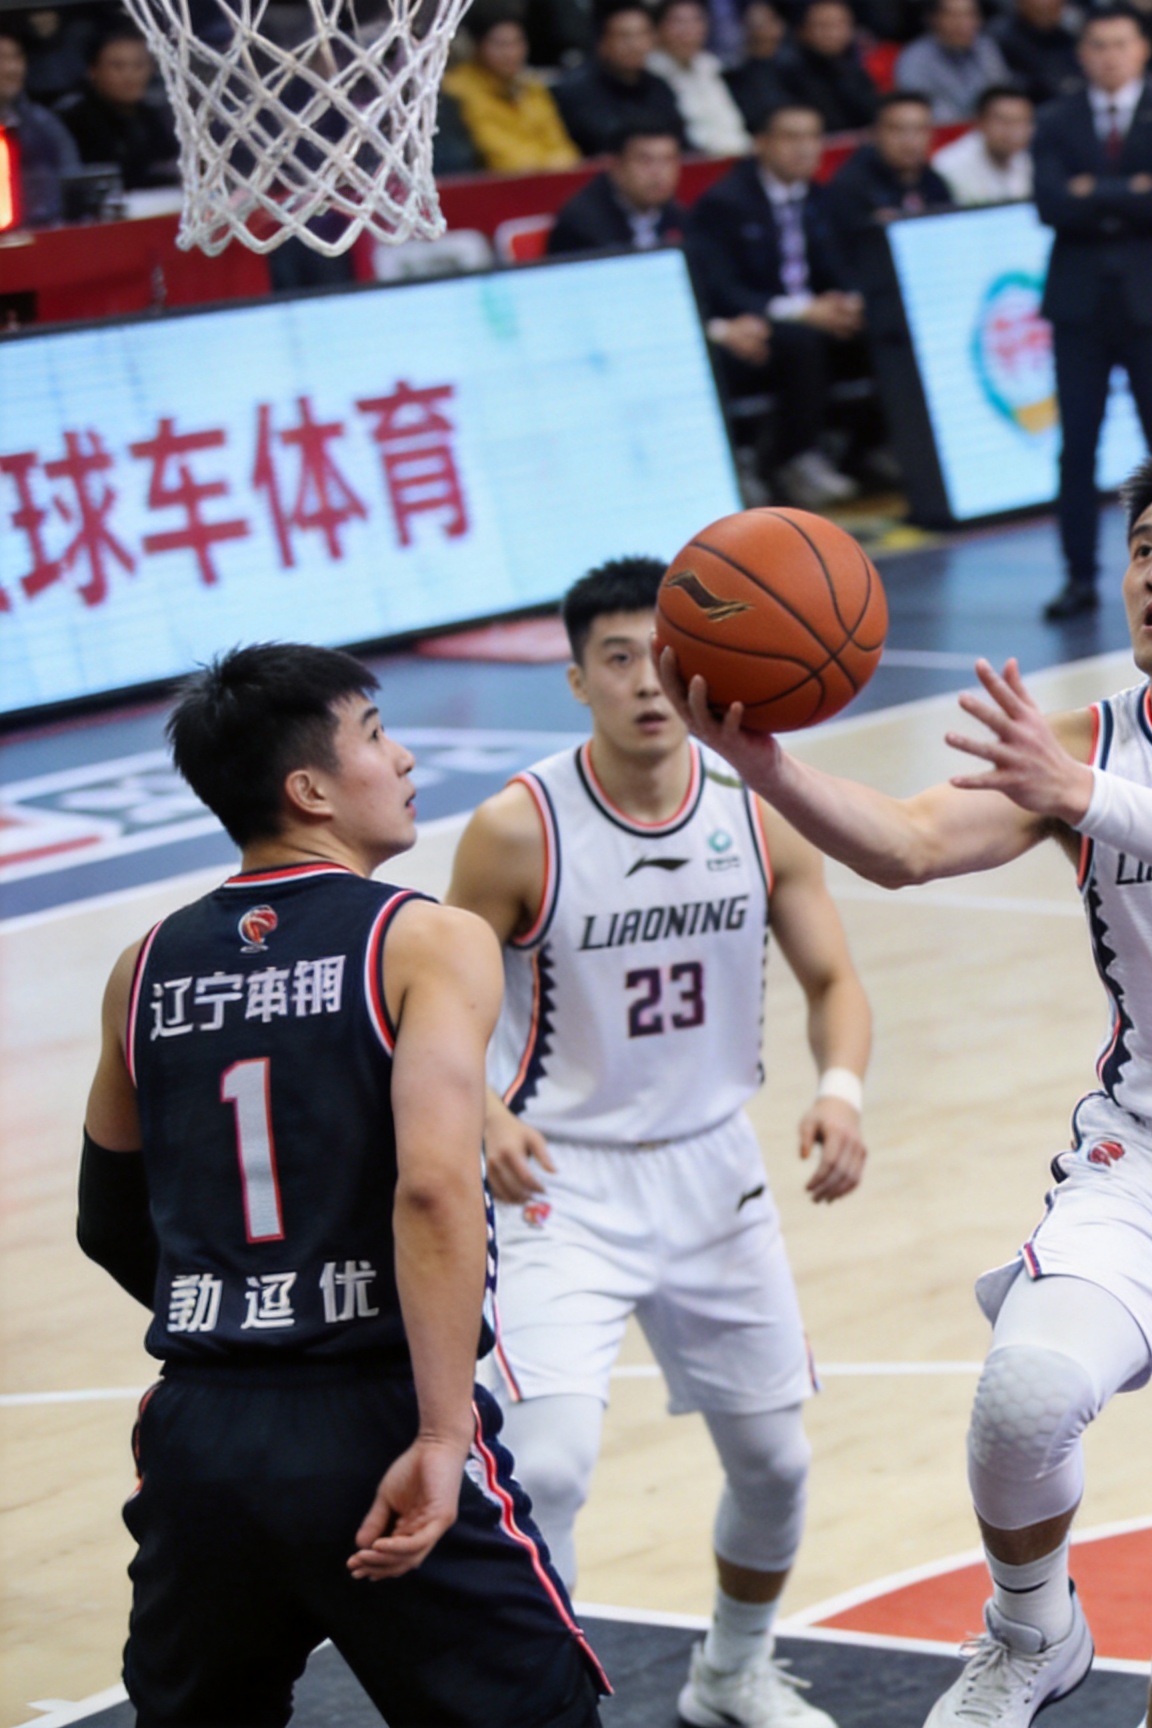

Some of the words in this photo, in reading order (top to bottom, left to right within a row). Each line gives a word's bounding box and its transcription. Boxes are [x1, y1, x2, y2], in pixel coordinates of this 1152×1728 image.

[0, 379, 470, 613] 球车体育
[578, 894, 750, 951] LIAONING
[625, 960, 705, 1039] 23
[220, 1056, 286, 1245] 1
